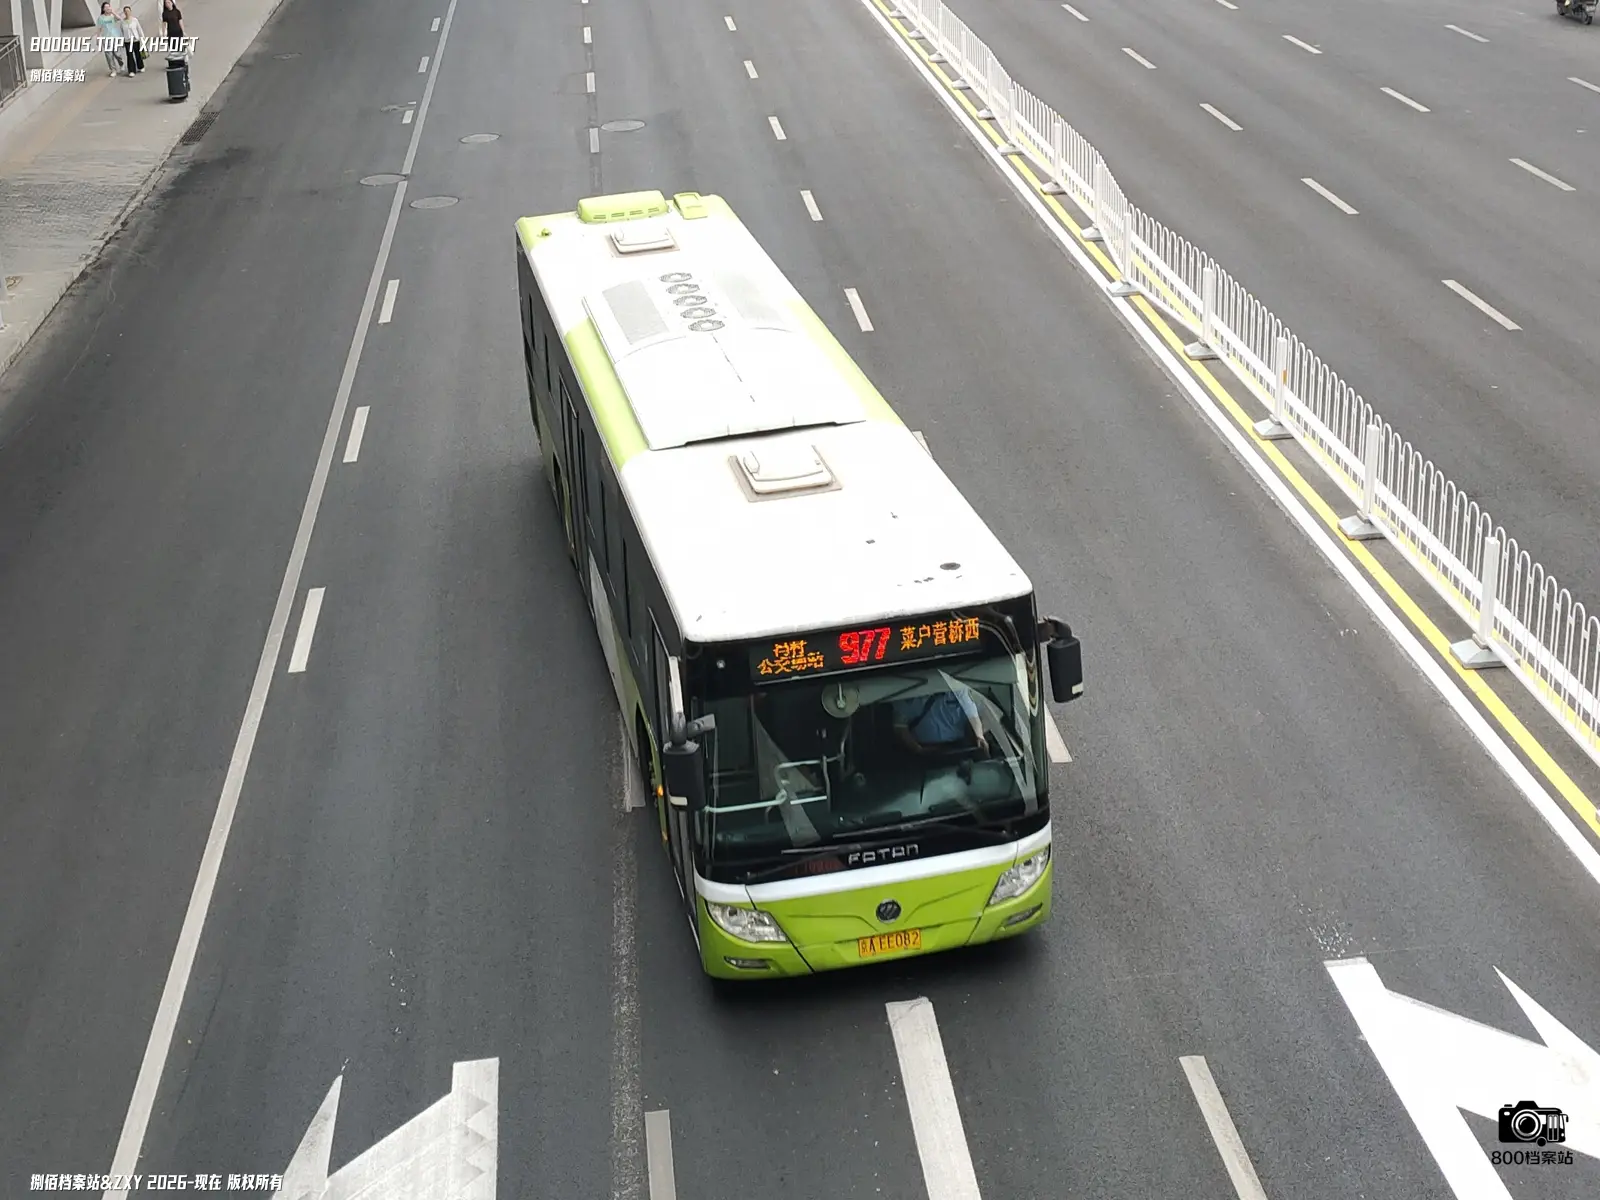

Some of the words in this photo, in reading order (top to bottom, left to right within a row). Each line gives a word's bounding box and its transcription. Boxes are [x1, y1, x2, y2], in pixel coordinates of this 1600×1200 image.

[839, 627, 891, 664] 977
[900, 617, 979, 650] 菜户营桥西
[848, 843, 919, 864] FOTON
